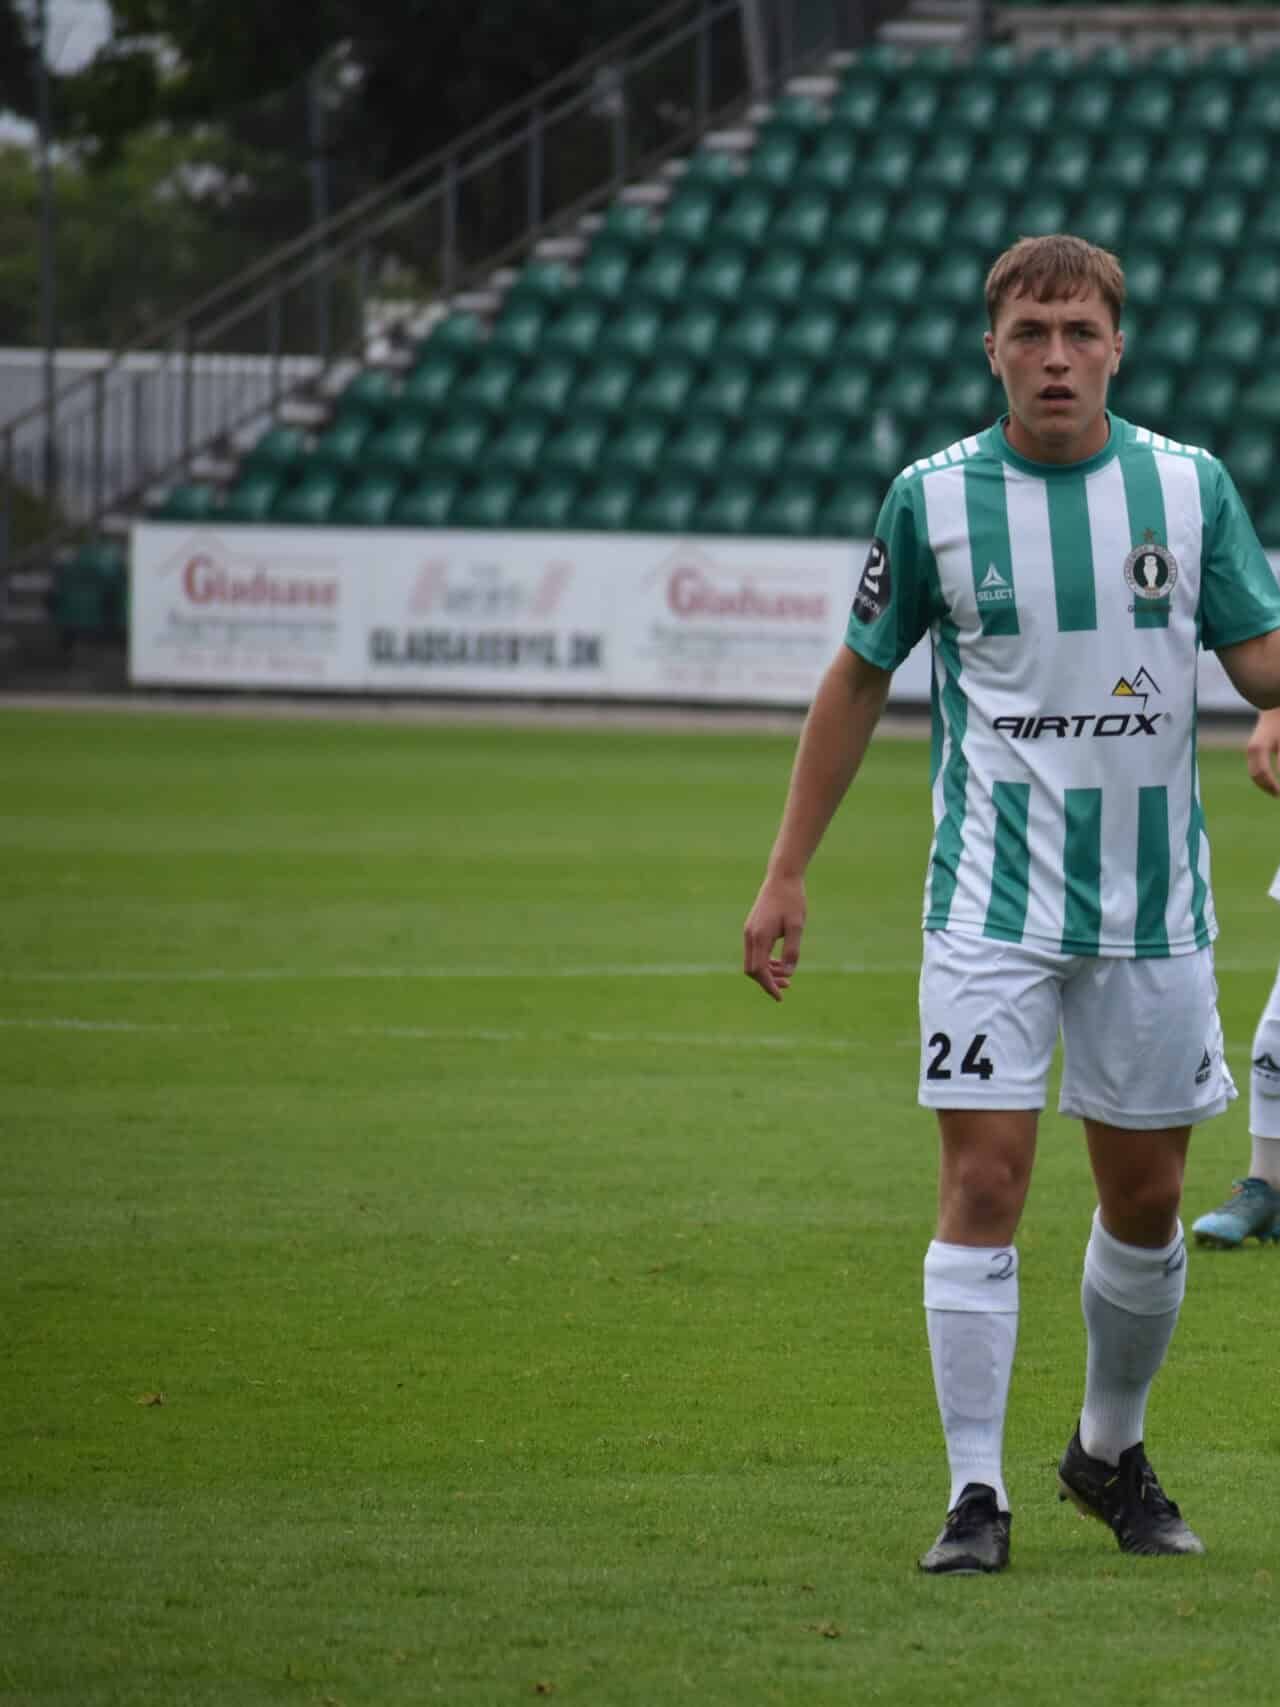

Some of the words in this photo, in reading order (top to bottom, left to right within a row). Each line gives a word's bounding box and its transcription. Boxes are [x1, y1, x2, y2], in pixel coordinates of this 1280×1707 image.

[977, 588, 1014, 601] SELECT
[992, 712, 1162, 739] AIRTOX
[926, 1032, 994, 1080] 24
